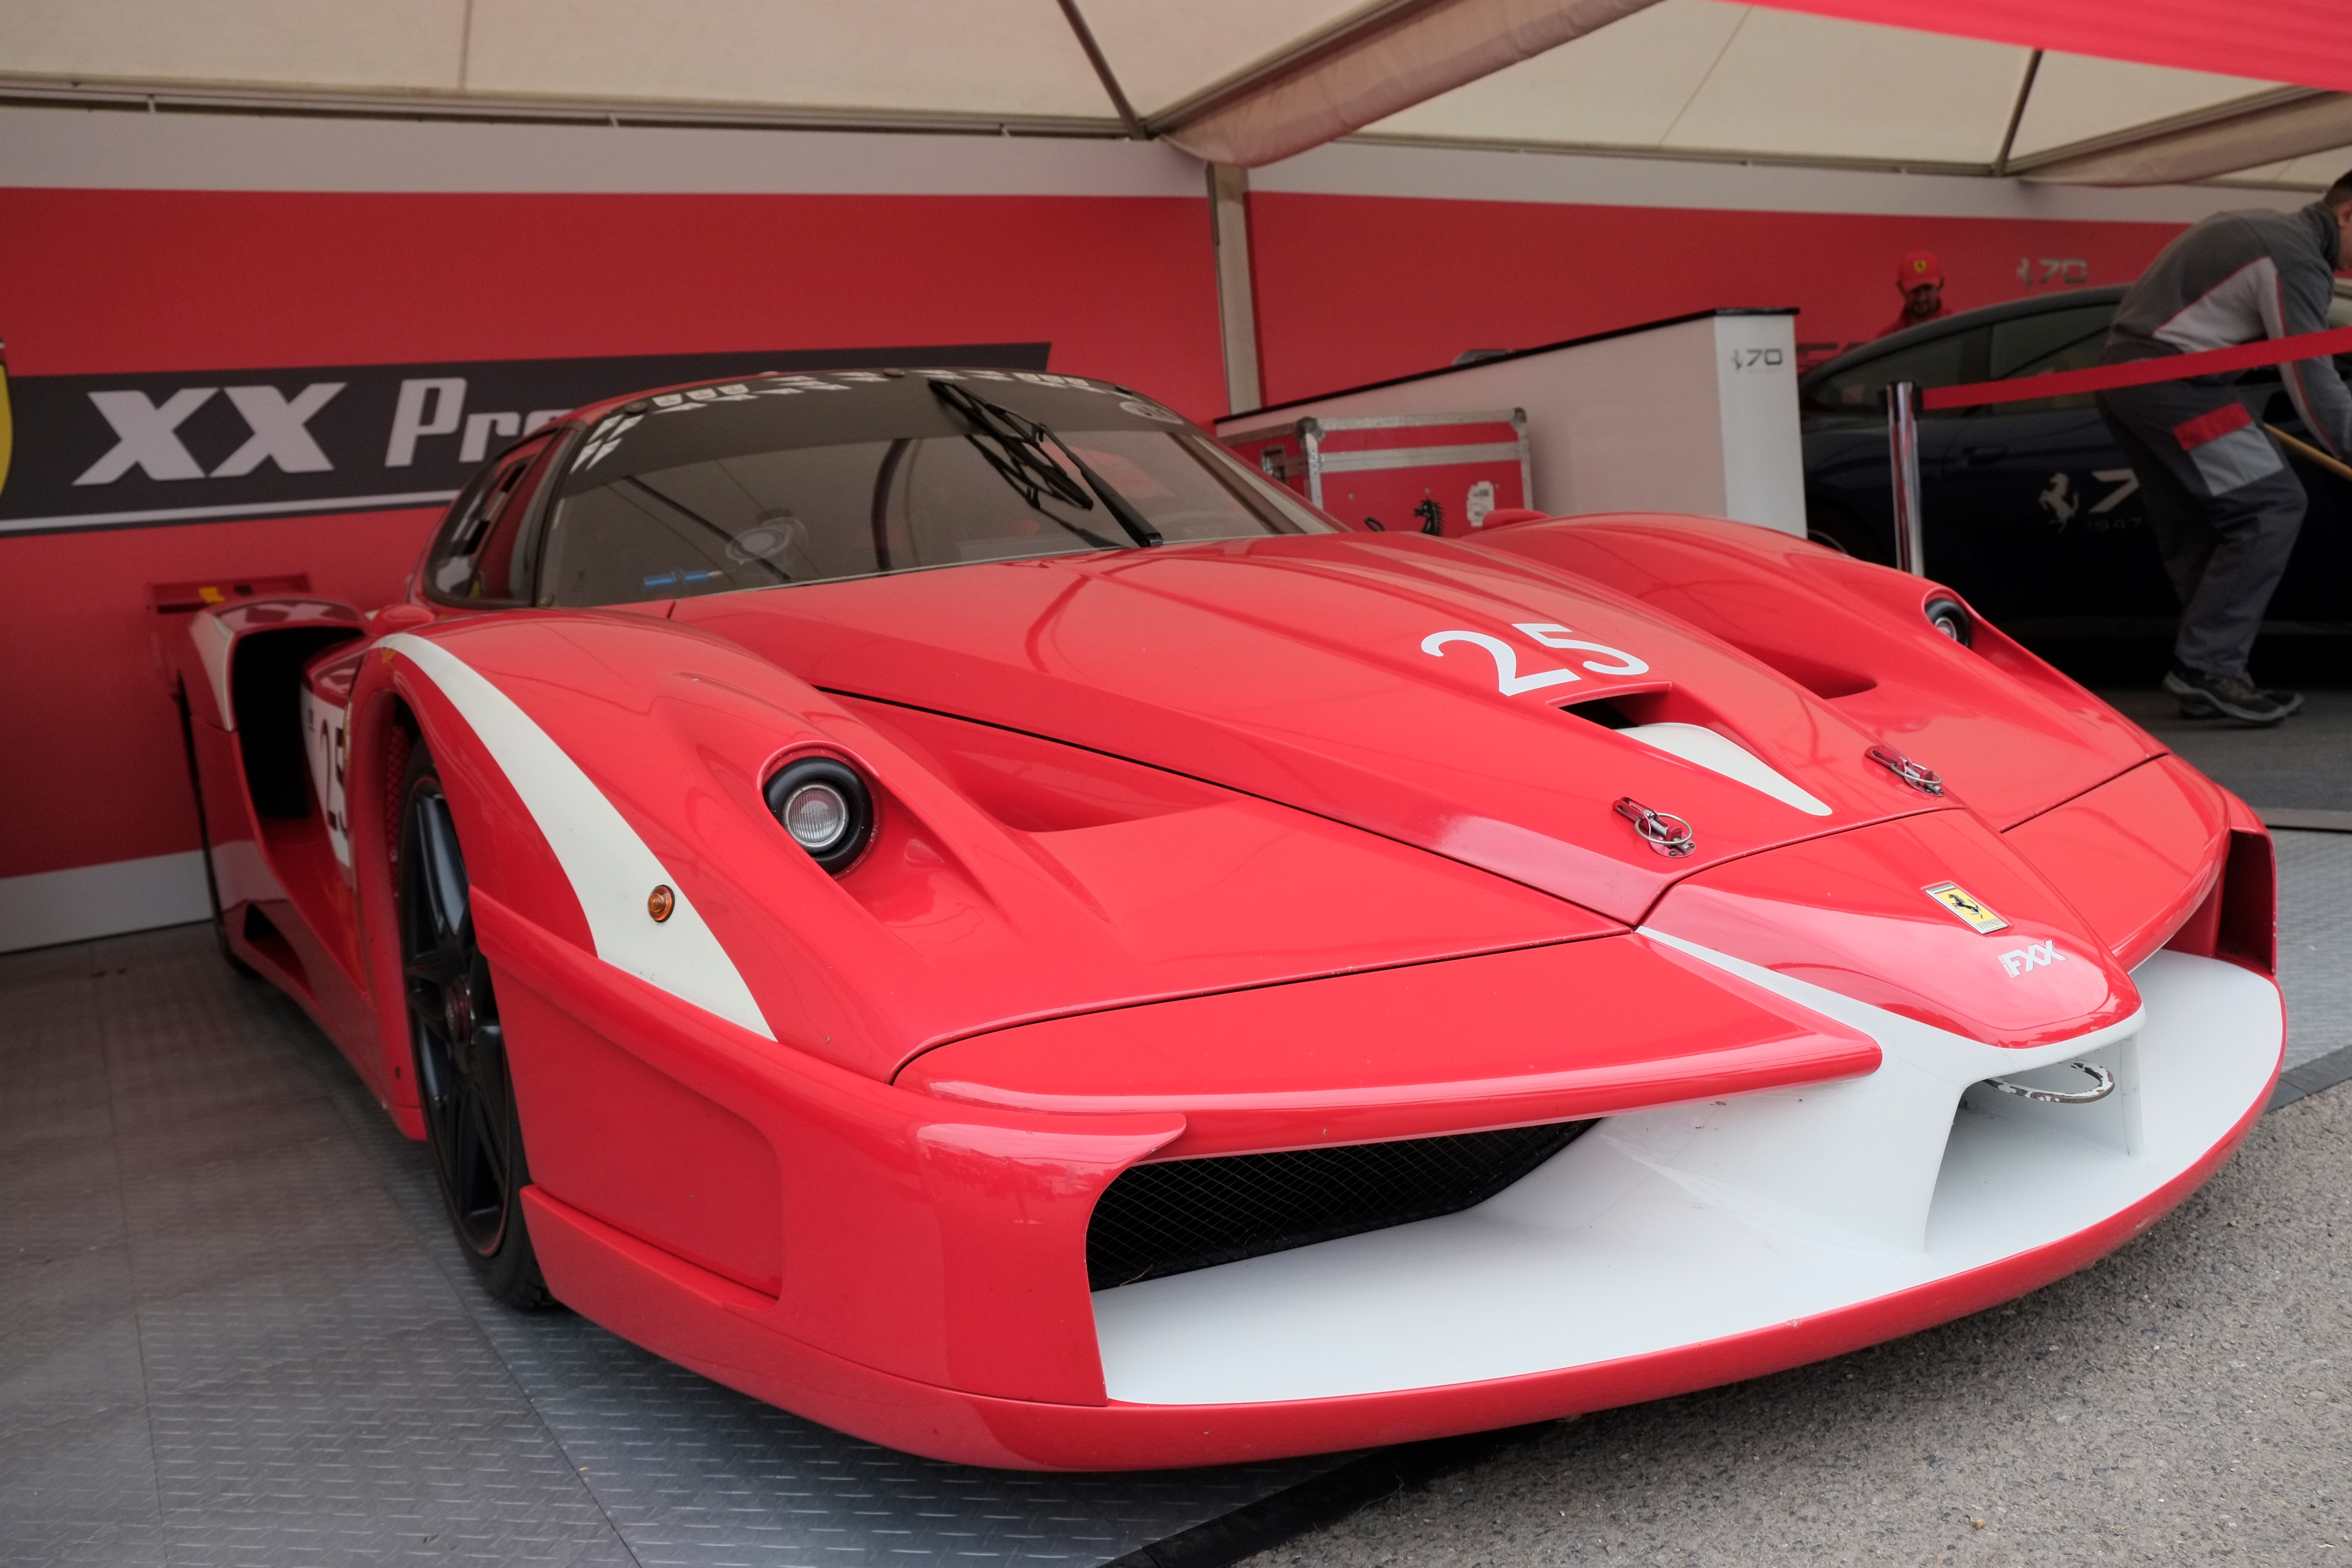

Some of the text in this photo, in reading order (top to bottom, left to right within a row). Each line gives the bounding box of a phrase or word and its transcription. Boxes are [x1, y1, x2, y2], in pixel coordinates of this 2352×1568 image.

[2038, 257, 2088, 284] 70
[1746, 348, 1783, 366] 70
[72, 382, 348, 485] XX
[1421, 623, 1650, 697] 25
[2001, 939, 2068, 977] FXX
